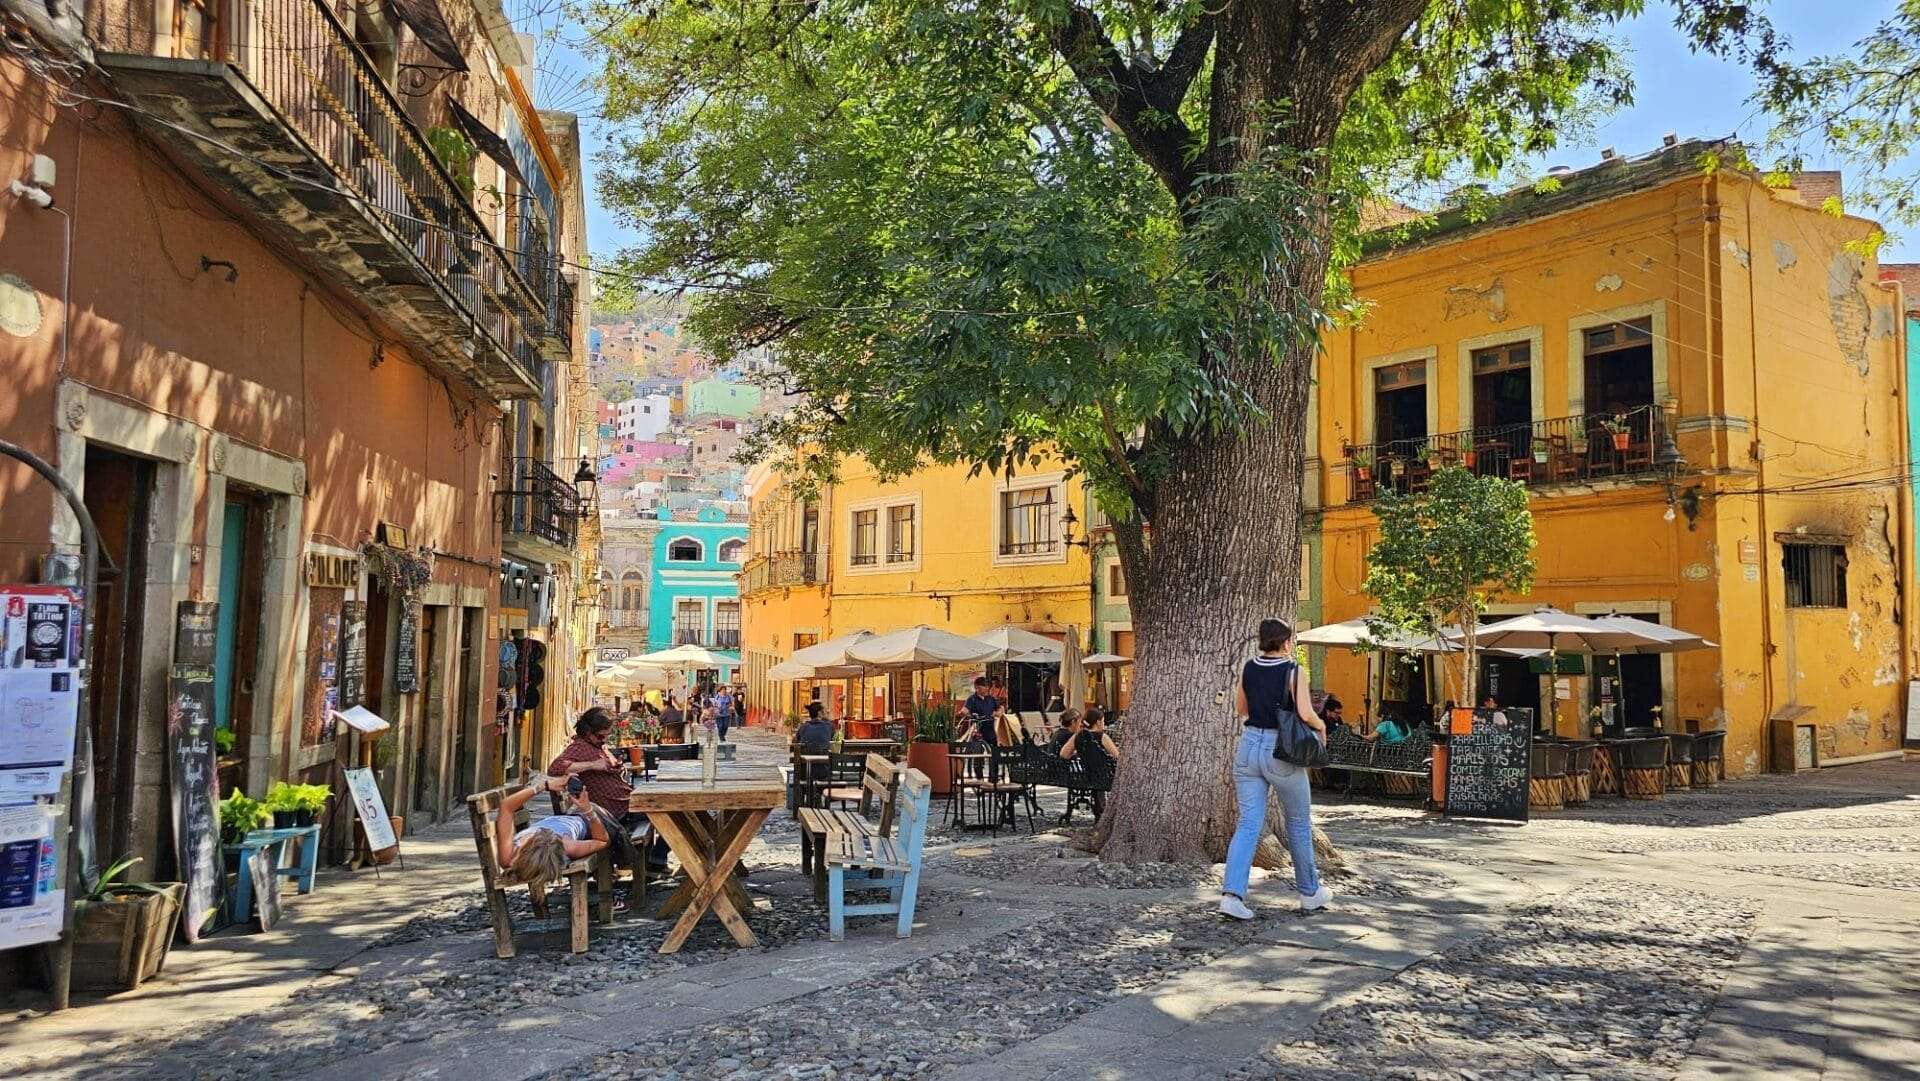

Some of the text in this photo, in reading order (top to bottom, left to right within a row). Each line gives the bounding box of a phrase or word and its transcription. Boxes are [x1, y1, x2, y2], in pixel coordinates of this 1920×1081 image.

[603, 651, 628, 661] OXXO
[1450, 754, 1509, 766] MARISOS
[1487, 767, 1527, 778] EXICANA
[1449, 784, 1498, 795] BONELESS
[1448, 792, 1504, 803] ENSALADAS
[1447, 800, 1487, 811] PASTAS
